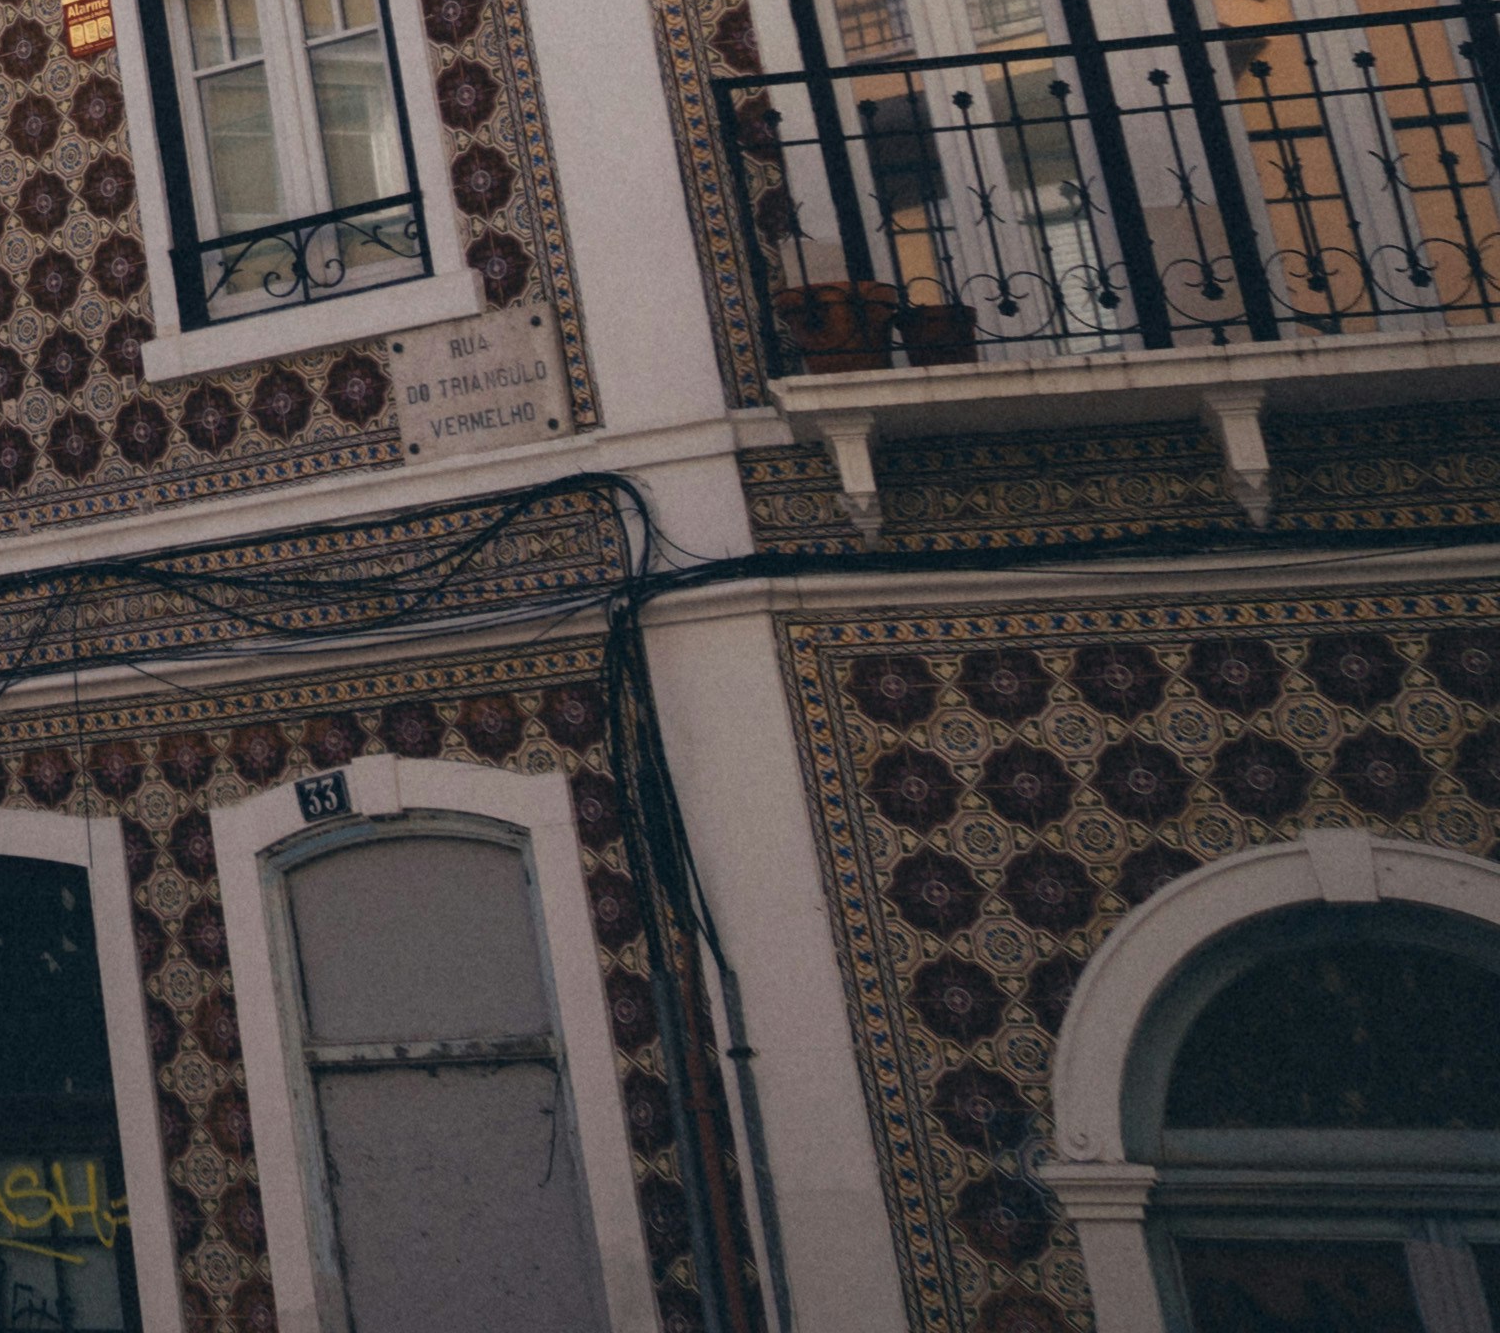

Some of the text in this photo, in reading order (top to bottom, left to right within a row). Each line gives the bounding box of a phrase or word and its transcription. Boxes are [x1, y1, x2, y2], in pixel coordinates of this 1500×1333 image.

[449, 334, 490, 359] RUA
[406, 383, 430, 405] DO
[430, 402, 535, 439] VERMELHO
[304, 778, 338, 815] 33
